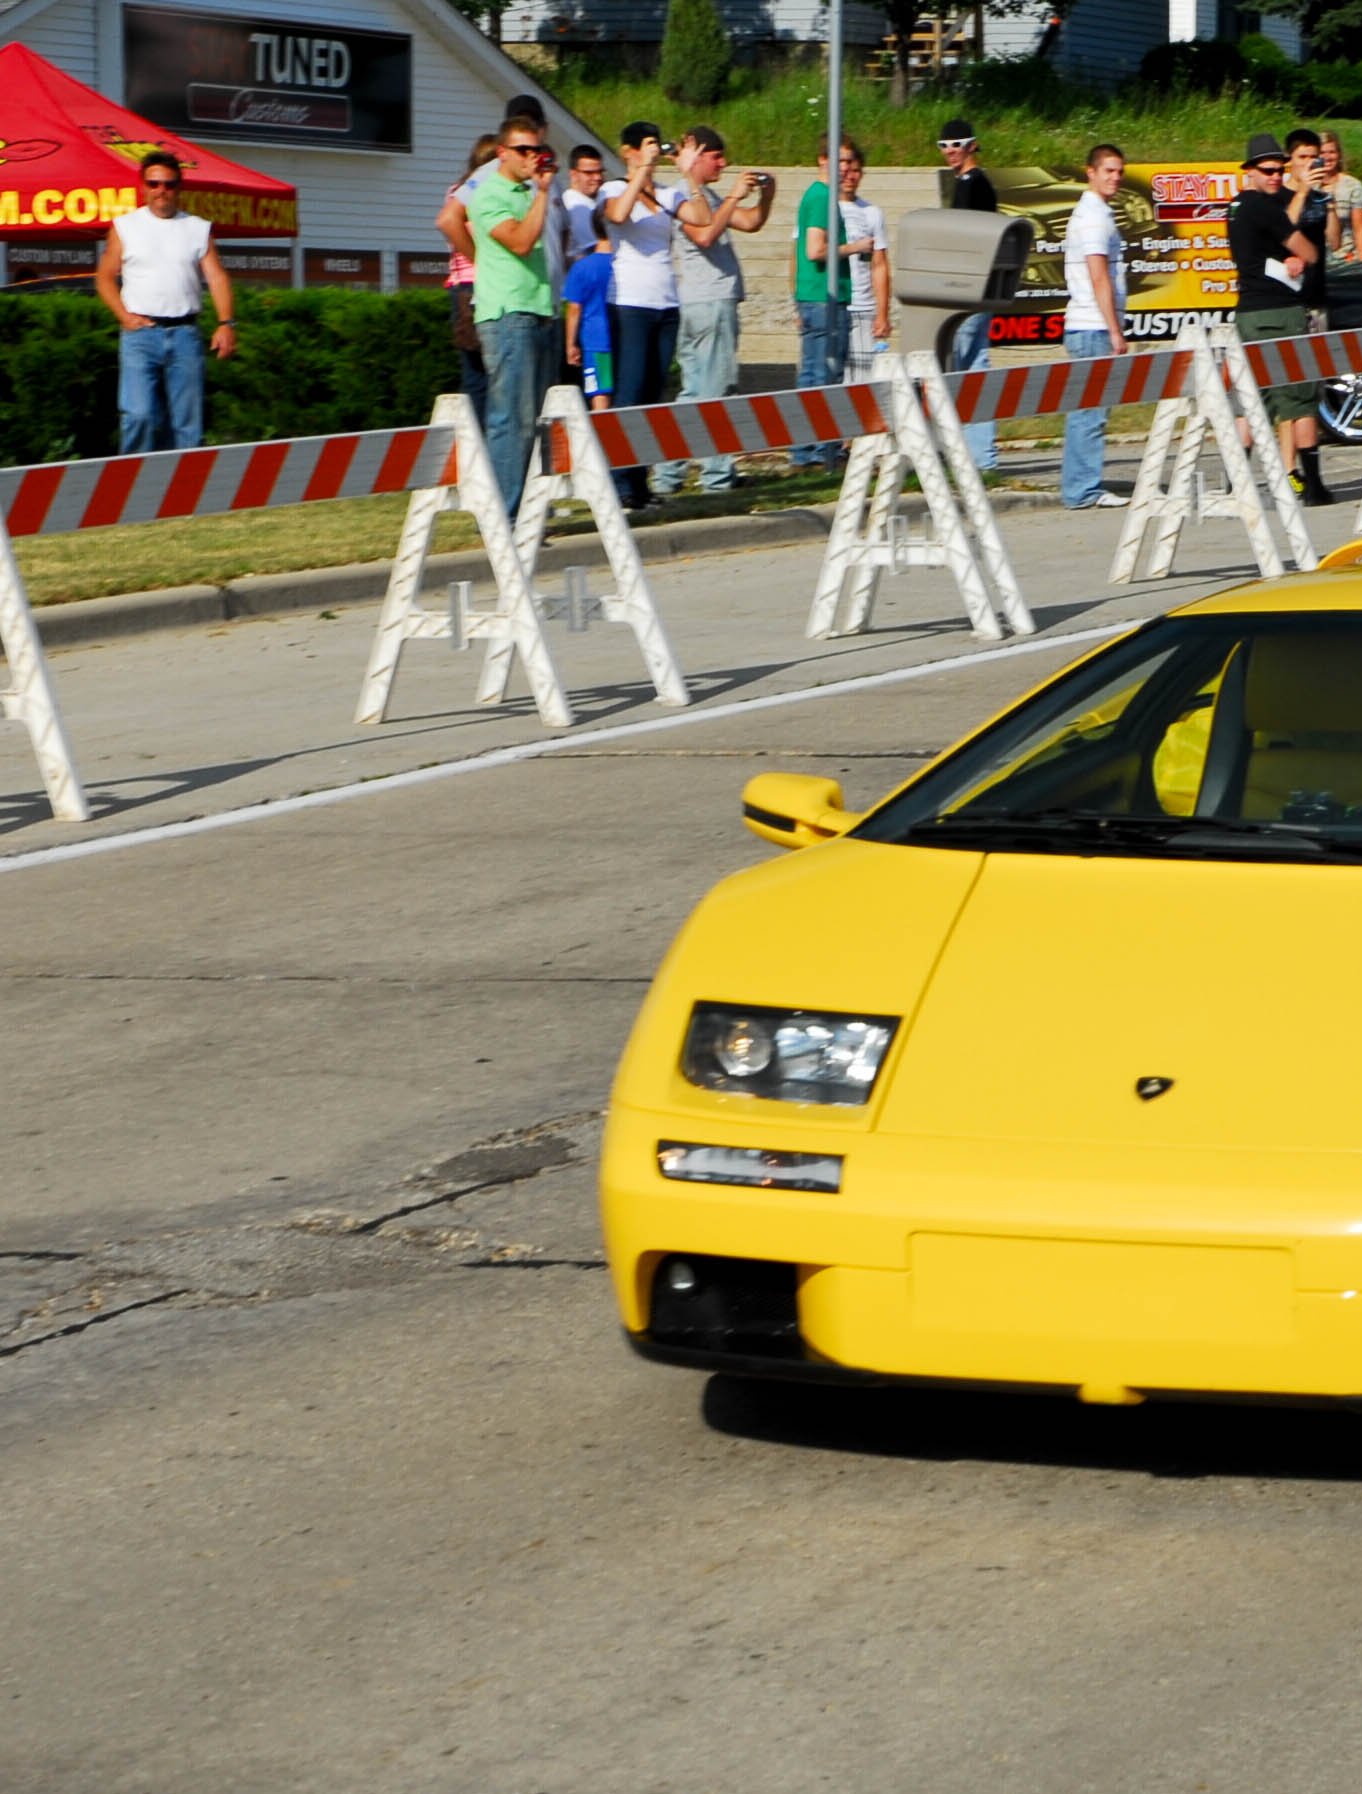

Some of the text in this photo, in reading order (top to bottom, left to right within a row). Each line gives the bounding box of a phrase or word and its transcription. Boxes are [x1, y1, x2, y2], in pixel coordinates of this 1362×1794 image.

[248, 33, 350, 88] TUNED
[1142, 236, 1190, 252] Engine
[1193, 236, 1204, 249] &
[1131, 259, 1177, 273] Stereo
[988, 316, 1041, 340] ONE
[1123, 311, 1223, 336] CUSTOM
